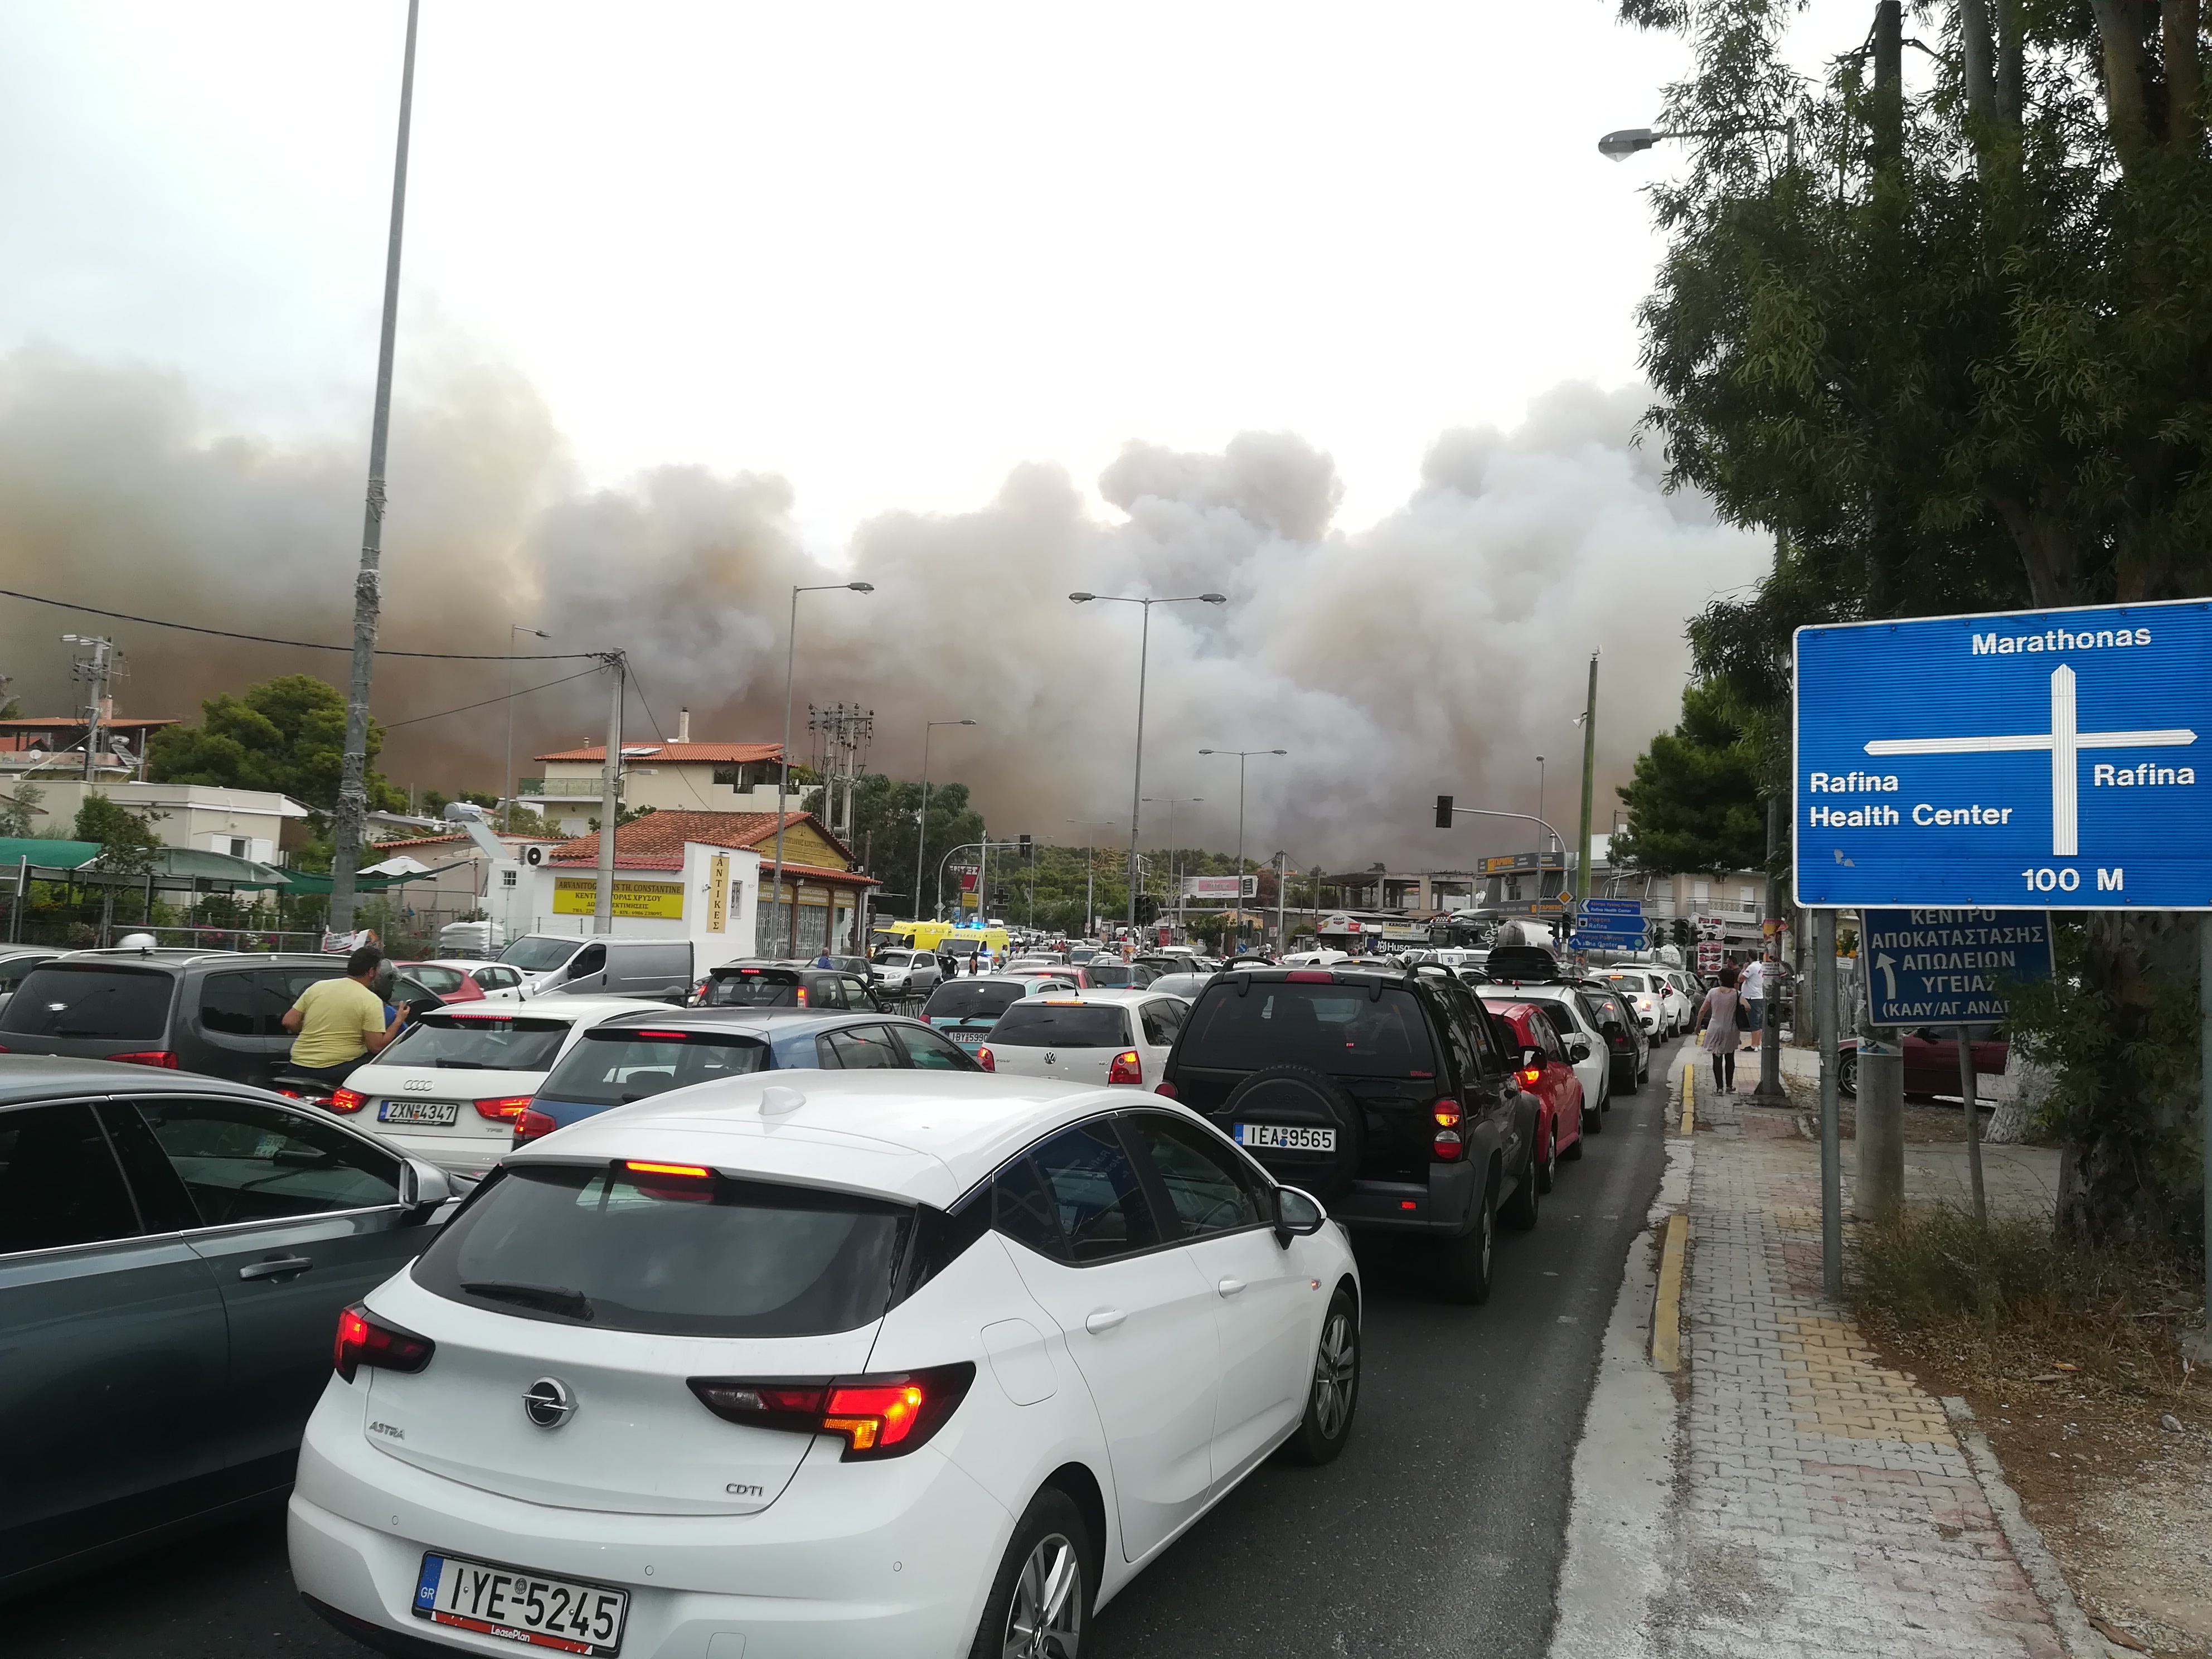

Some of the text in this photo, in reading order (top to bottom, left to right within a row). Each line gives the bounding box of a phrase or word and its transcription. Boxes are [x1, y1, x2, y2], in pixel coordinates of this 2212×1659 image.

[1972, 628, 2151, 655] Marathonas
[1810, 772, 1898, 793] Rafina
[2094, 763, 2195, 786] Rafina
[1810, 803, 2012, 827] Health Center
[634, 884, 681, 894] CONSTANTINE
[2021, 868, 2123, 891] 100 M
[713, 858, 723, 929] ΑΝΤΙΚΕΣ
[1871, 926, 2044, 949] ΑΠΟΚΑΤΑΣΤΑΣΗΣ
[1903, 950, 2016, 971] ΑΠΩΛΕΙΩΝ
[368, 1421, 405, 1440] ASTRA
[725, 1483, 764, 1497] CDTI
[420, 1587, 435, 1600] GR
[491, 1624, 530, 1642] LeasePlan
